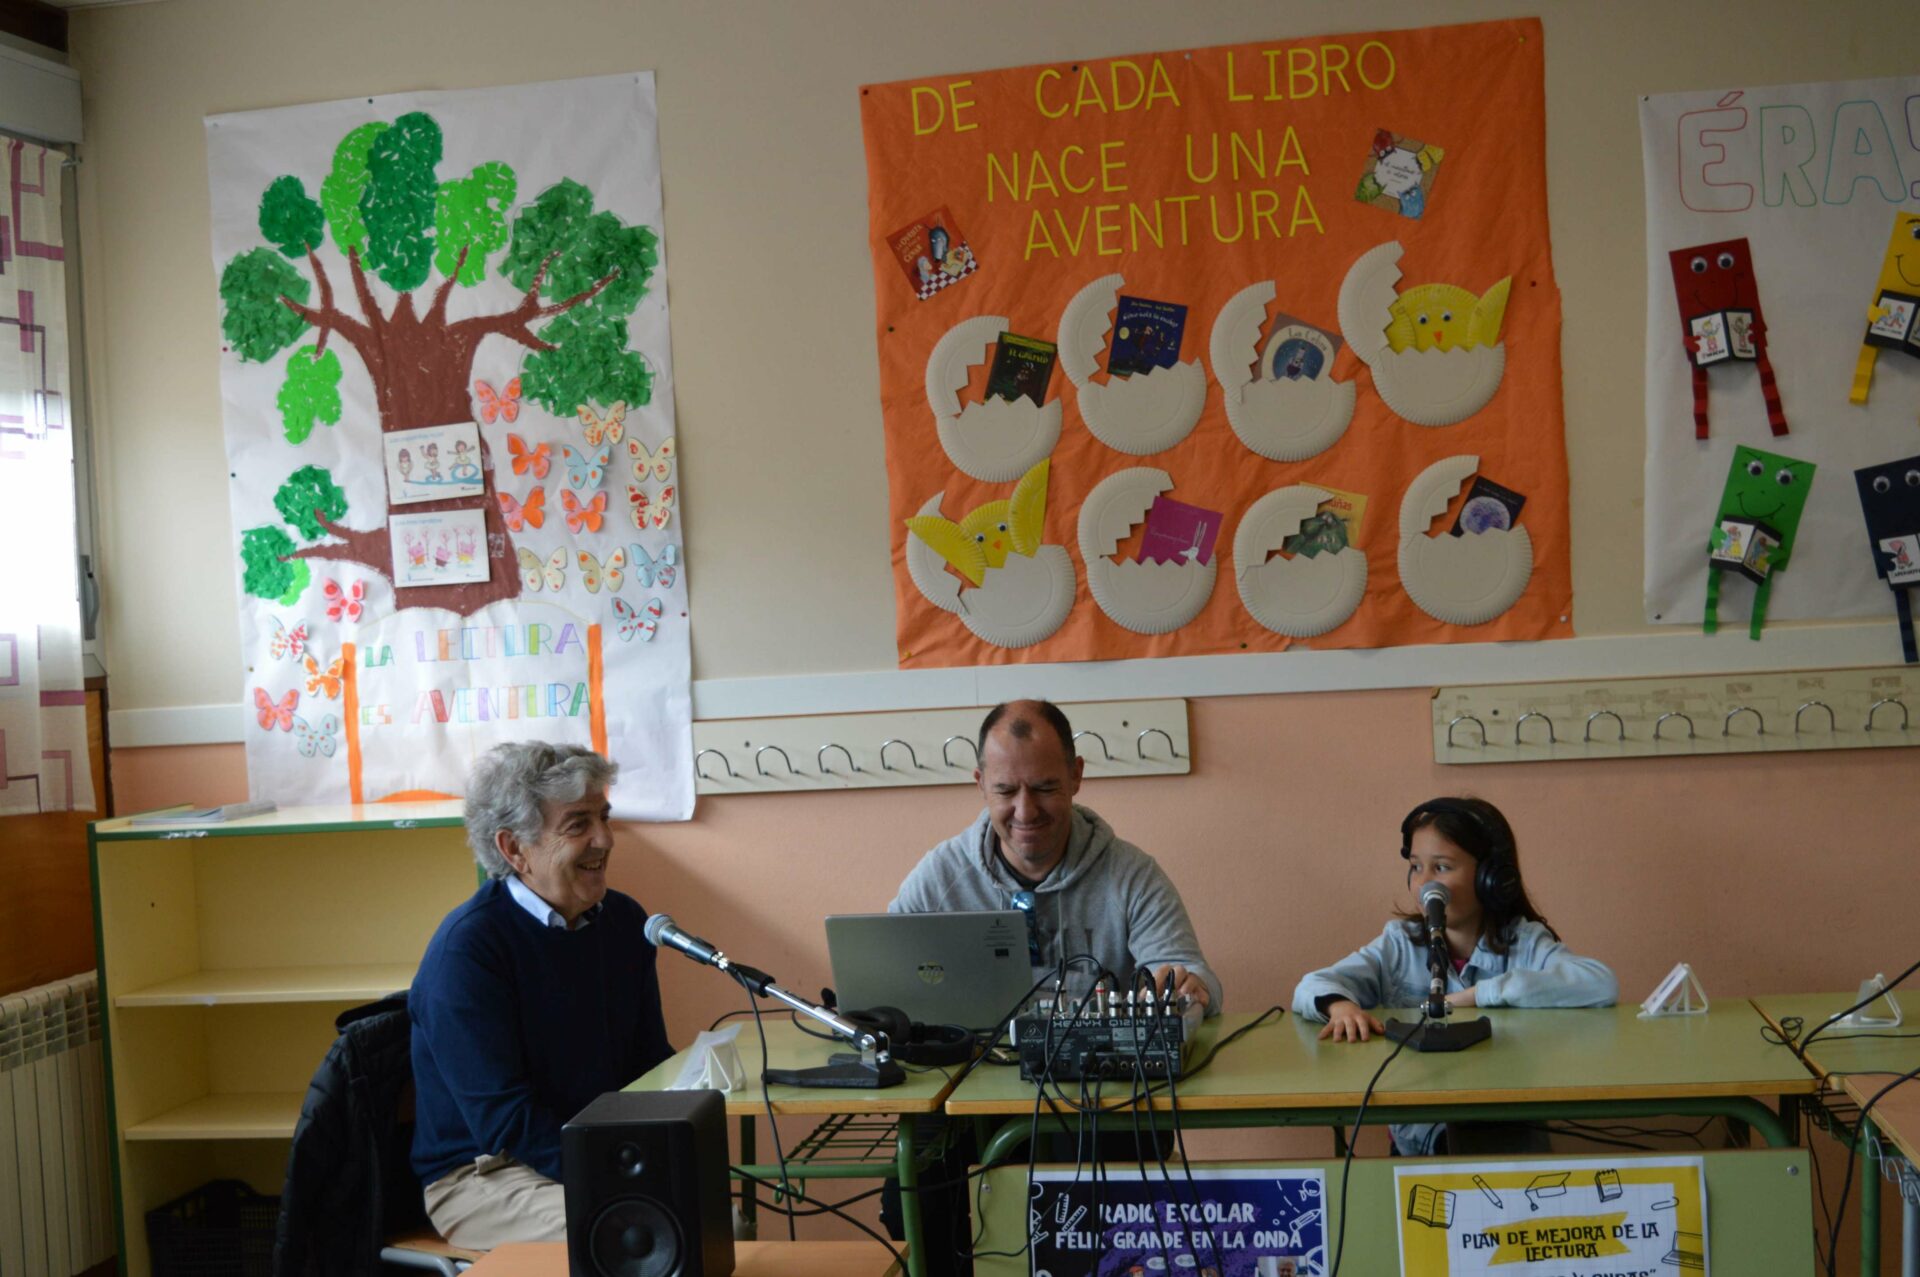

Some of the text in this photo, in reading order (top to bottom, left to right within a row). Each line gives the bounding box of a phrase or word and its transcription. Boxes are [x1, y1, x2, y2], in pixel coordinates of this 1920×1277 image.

[911, 40, 1396, 136] DE CADA LIBRO
[986, 126, 1310, 202] NACE UNA
[1677, 90, 1920, 213] ÉRA
[1024, 185, 1325, 260] AVENTURA
[364, 623, 585, 668] LA LECTURA
[361, 682, 592, 725] ES AVENTURA
[1166, 1203, 1255, 1223] ESCOLAR
[1113, 1231, 1183, 1249] GRANDE
[1191, 1231, 1215, 1249] EN
[1223, 1231, 1246, 1249] LA
[1254, 1231, 1303, 1249] ONDA
[1462, 1222, 1660, 1249] PLAN DE MEJORA DE LA
[1525, 1242, 1599, 1262] LECTURA
